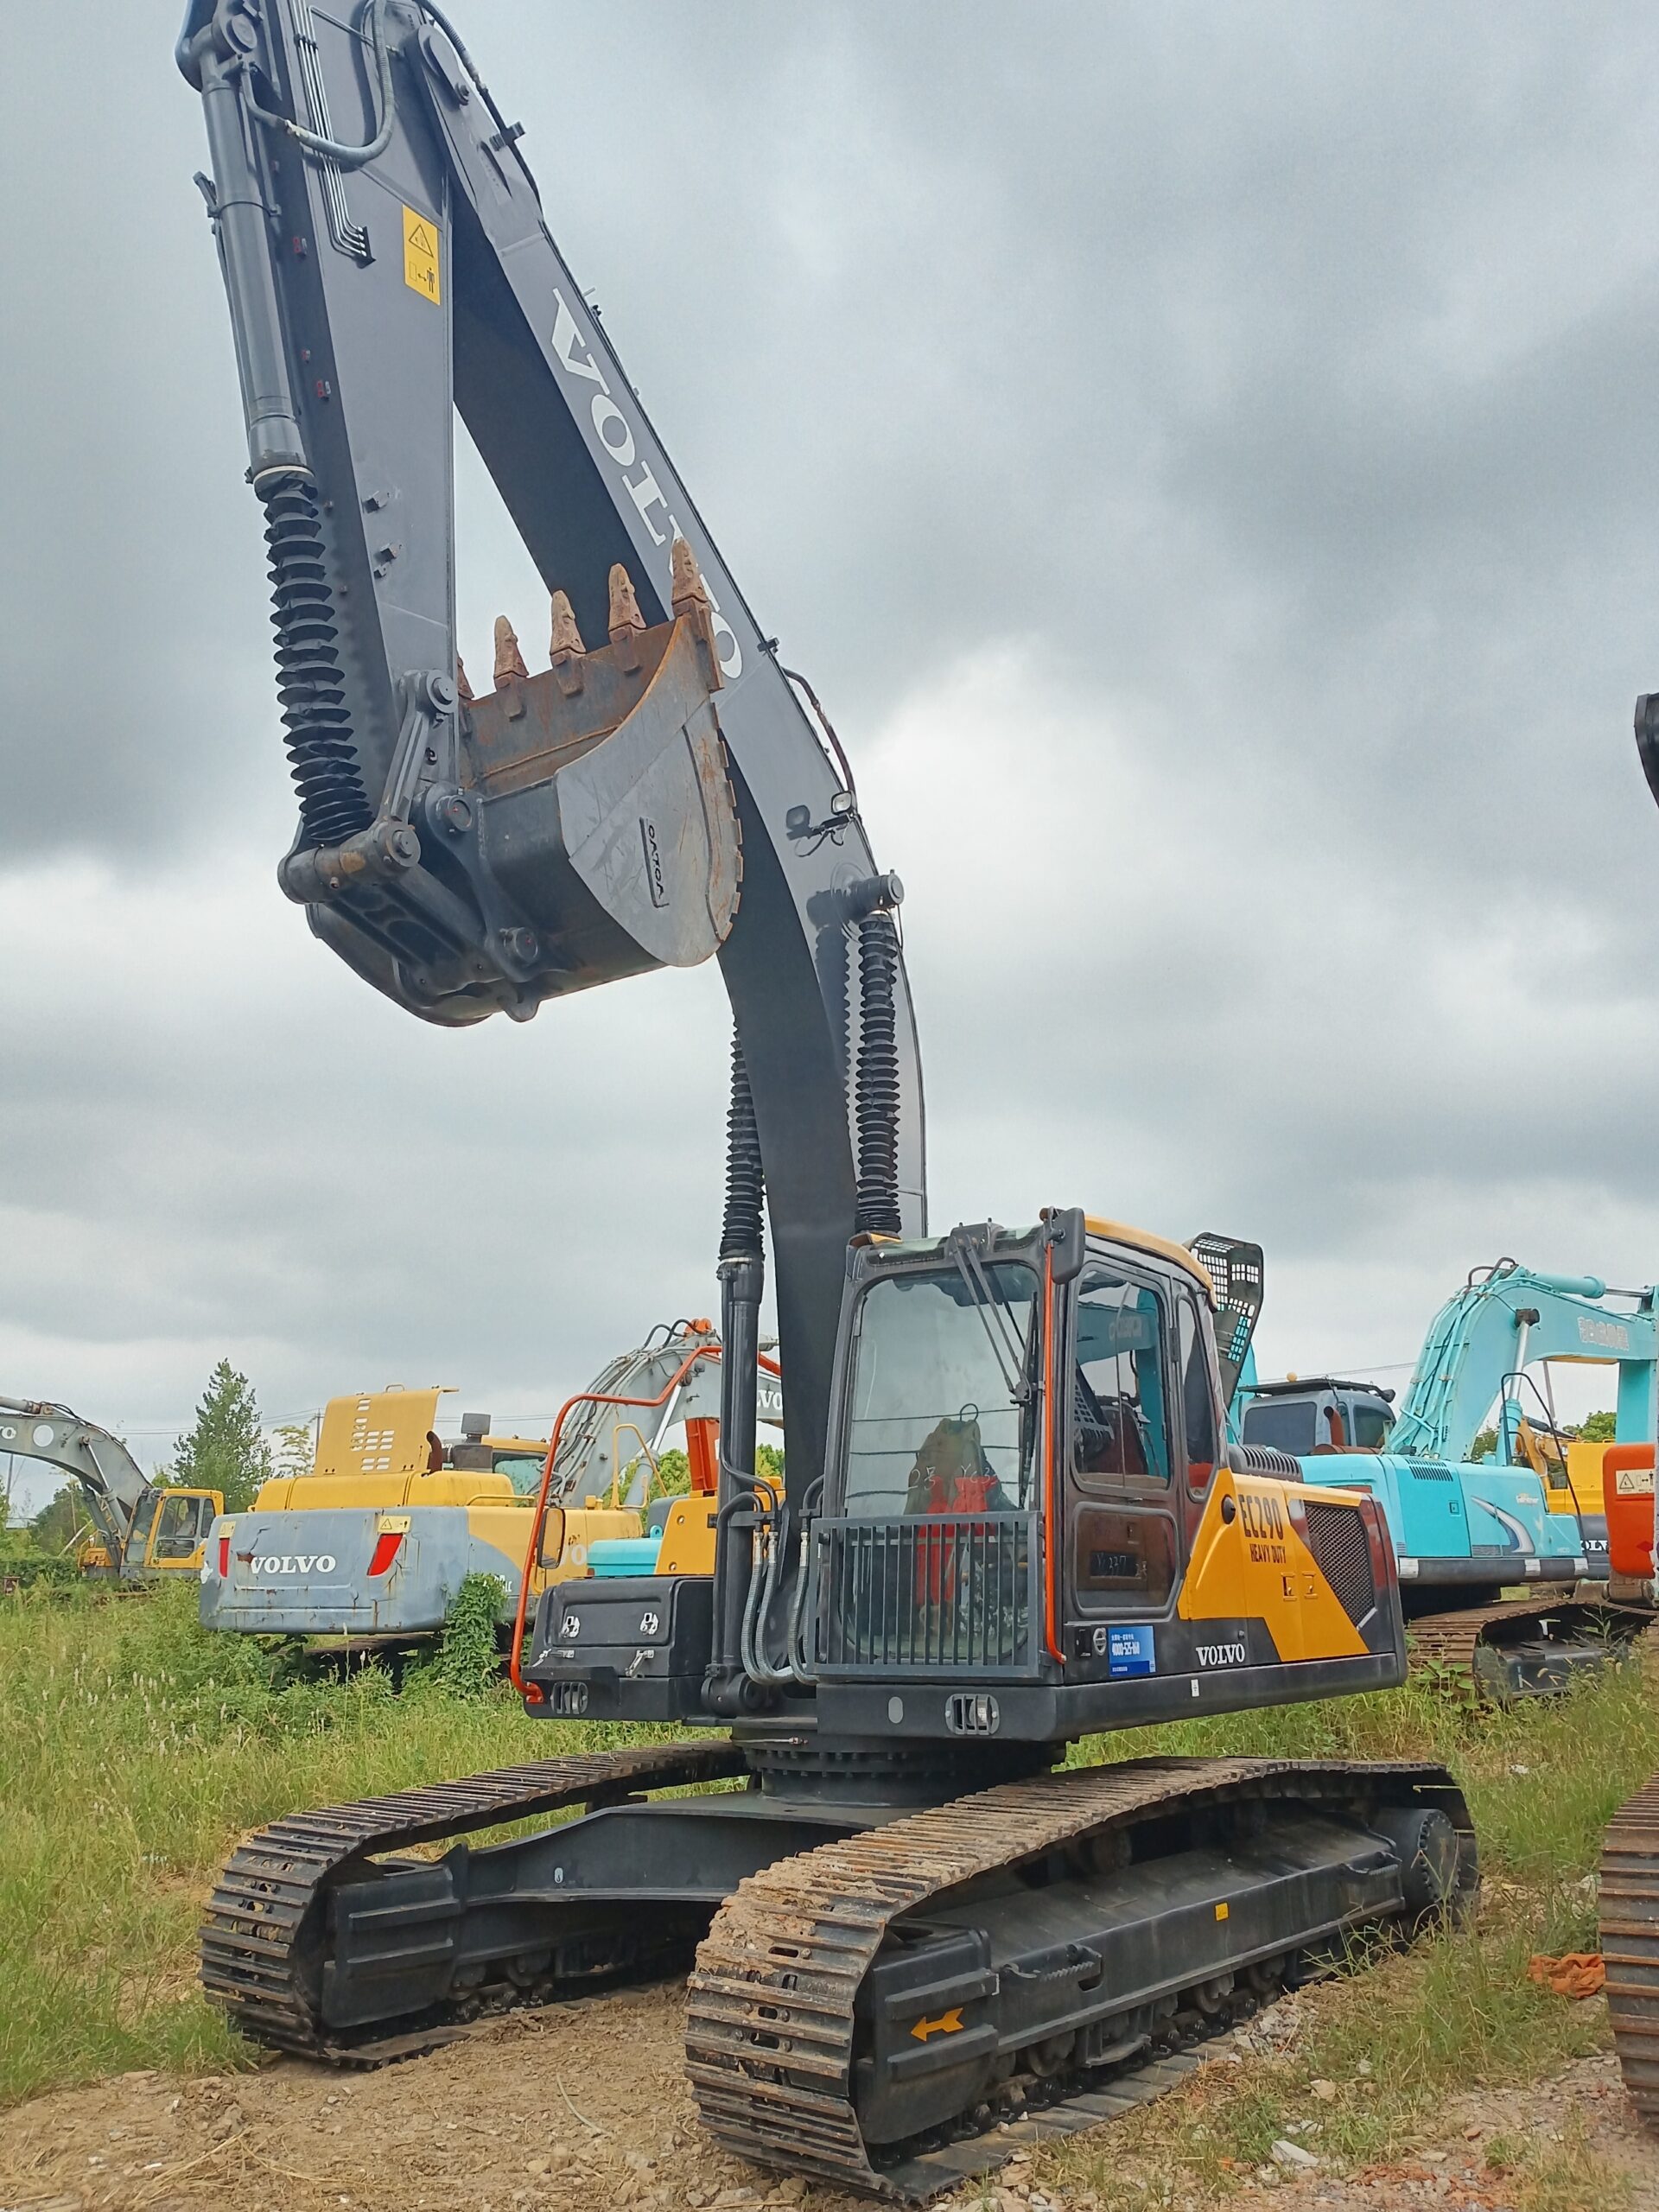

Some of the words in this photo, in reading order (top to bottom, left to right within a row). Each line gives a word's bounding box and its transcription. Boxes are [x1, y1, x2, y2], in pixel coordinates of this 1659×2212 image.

[648, 824, 664, 899] VOLVO
[1238, 1494, 1283, 1540] EC290
[251, 1555, 336, 1574] VOLVO
[1249, 1543, 1271, 1563] HEAVY
[1270, 1545, 1286, 1563] DUTY
[1195, 1643, 1245, 1666] VOLVO
